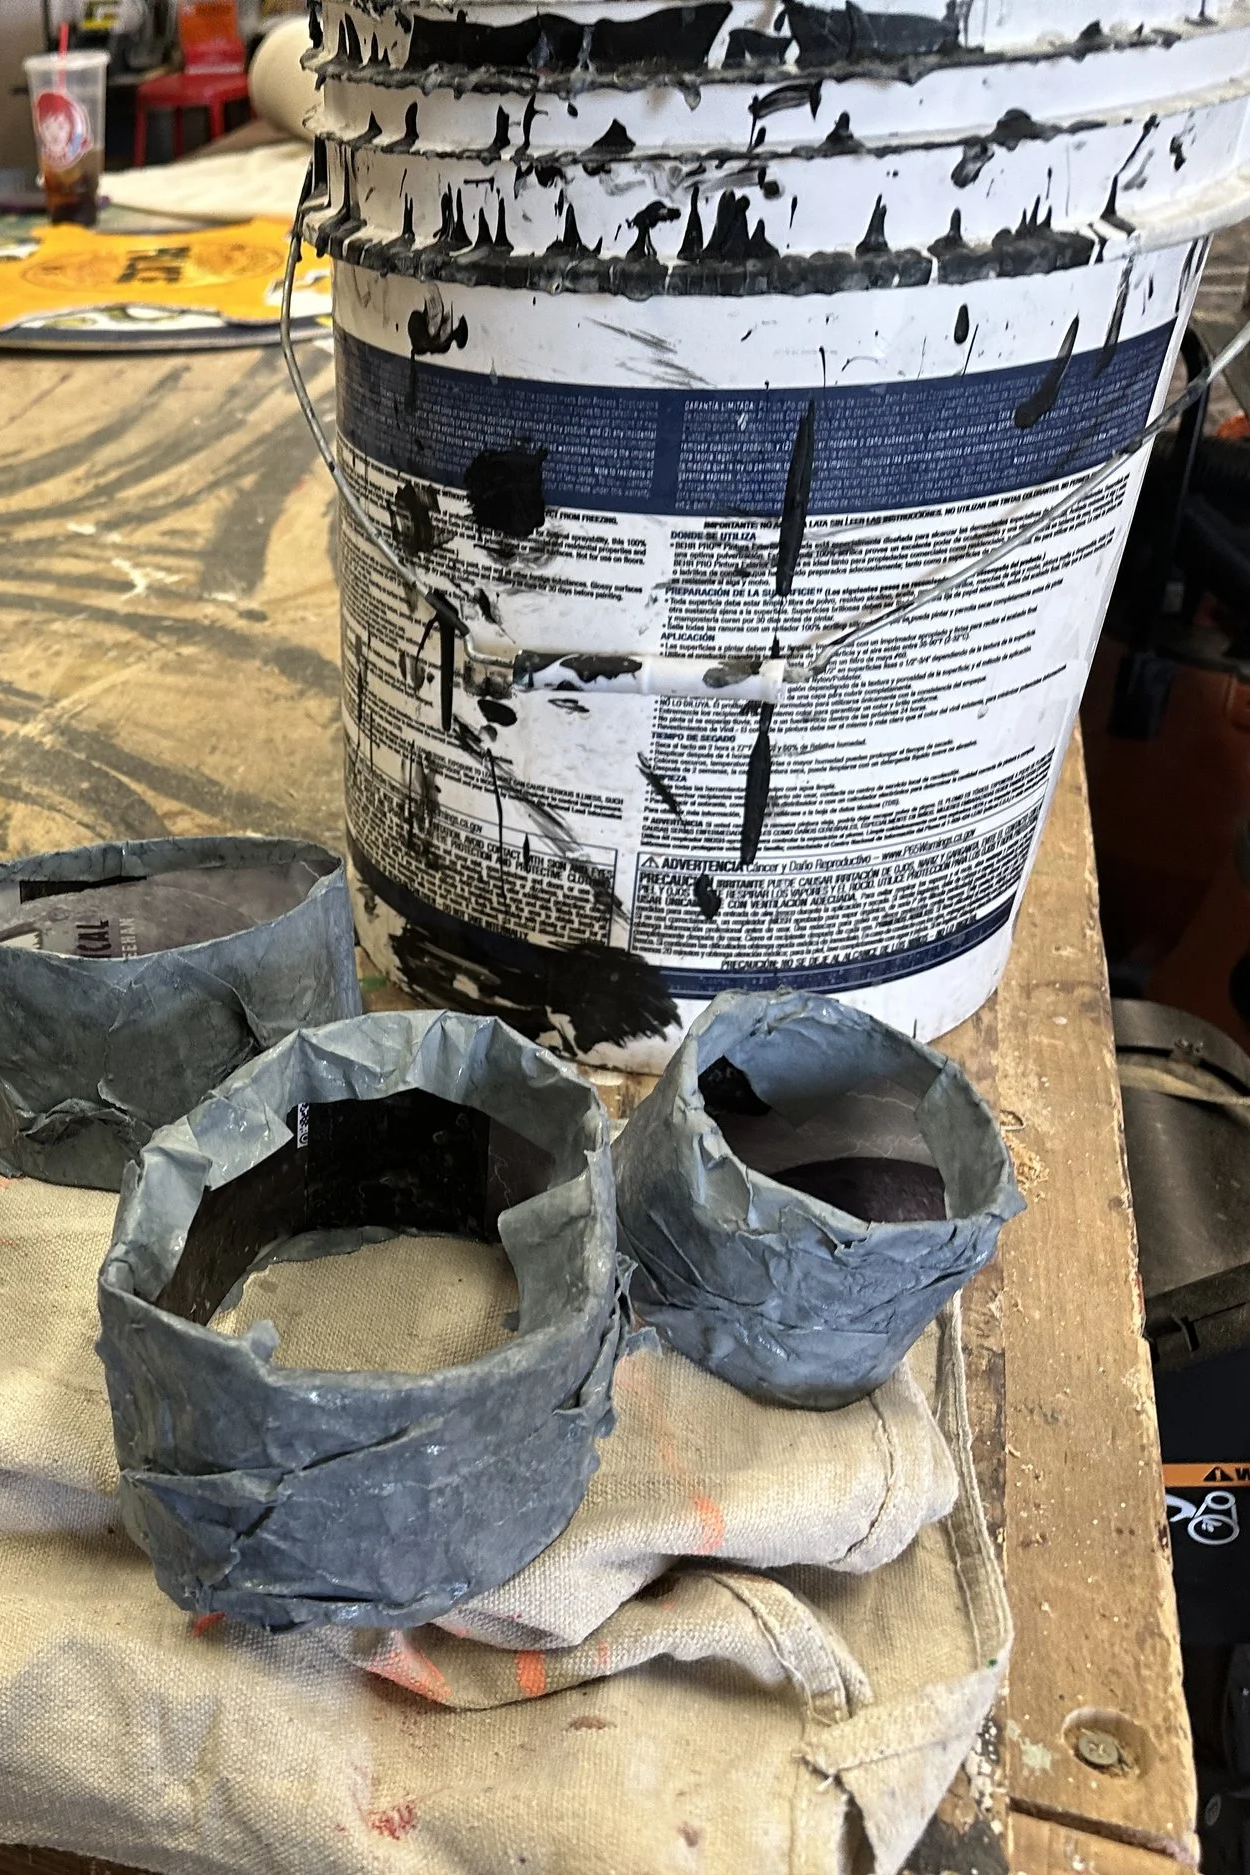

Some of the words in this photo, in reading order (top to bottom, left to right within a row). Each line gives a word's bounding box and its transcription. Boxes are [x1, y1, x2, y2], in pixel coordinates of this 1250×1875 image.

[720, 532, 756, 541] UTILIZA
[675, 541, 696, 550] BEHR
[665, 586, 730, 597] PREPARACIÓN
[733, 588, 745, 597] DE
[748, 589, 759, 597] LA
[660, 631, 716, 642] APLICACIÓN
[652, 732, 684, 741] TIEMPO
[686, 732, 698, 742] DE
[700, 733, 736, 743] SECADO
[661, 857, 743, 872] ADVERTENCIA
[789, 859, 813, 871] Daño
[815, 853, 871, 872] Reproductivo
[767, 878, 797, 889] PUEDE
[798, 875, 833, 886] CAUSAR
[770, 889, 789, 899] LOS
